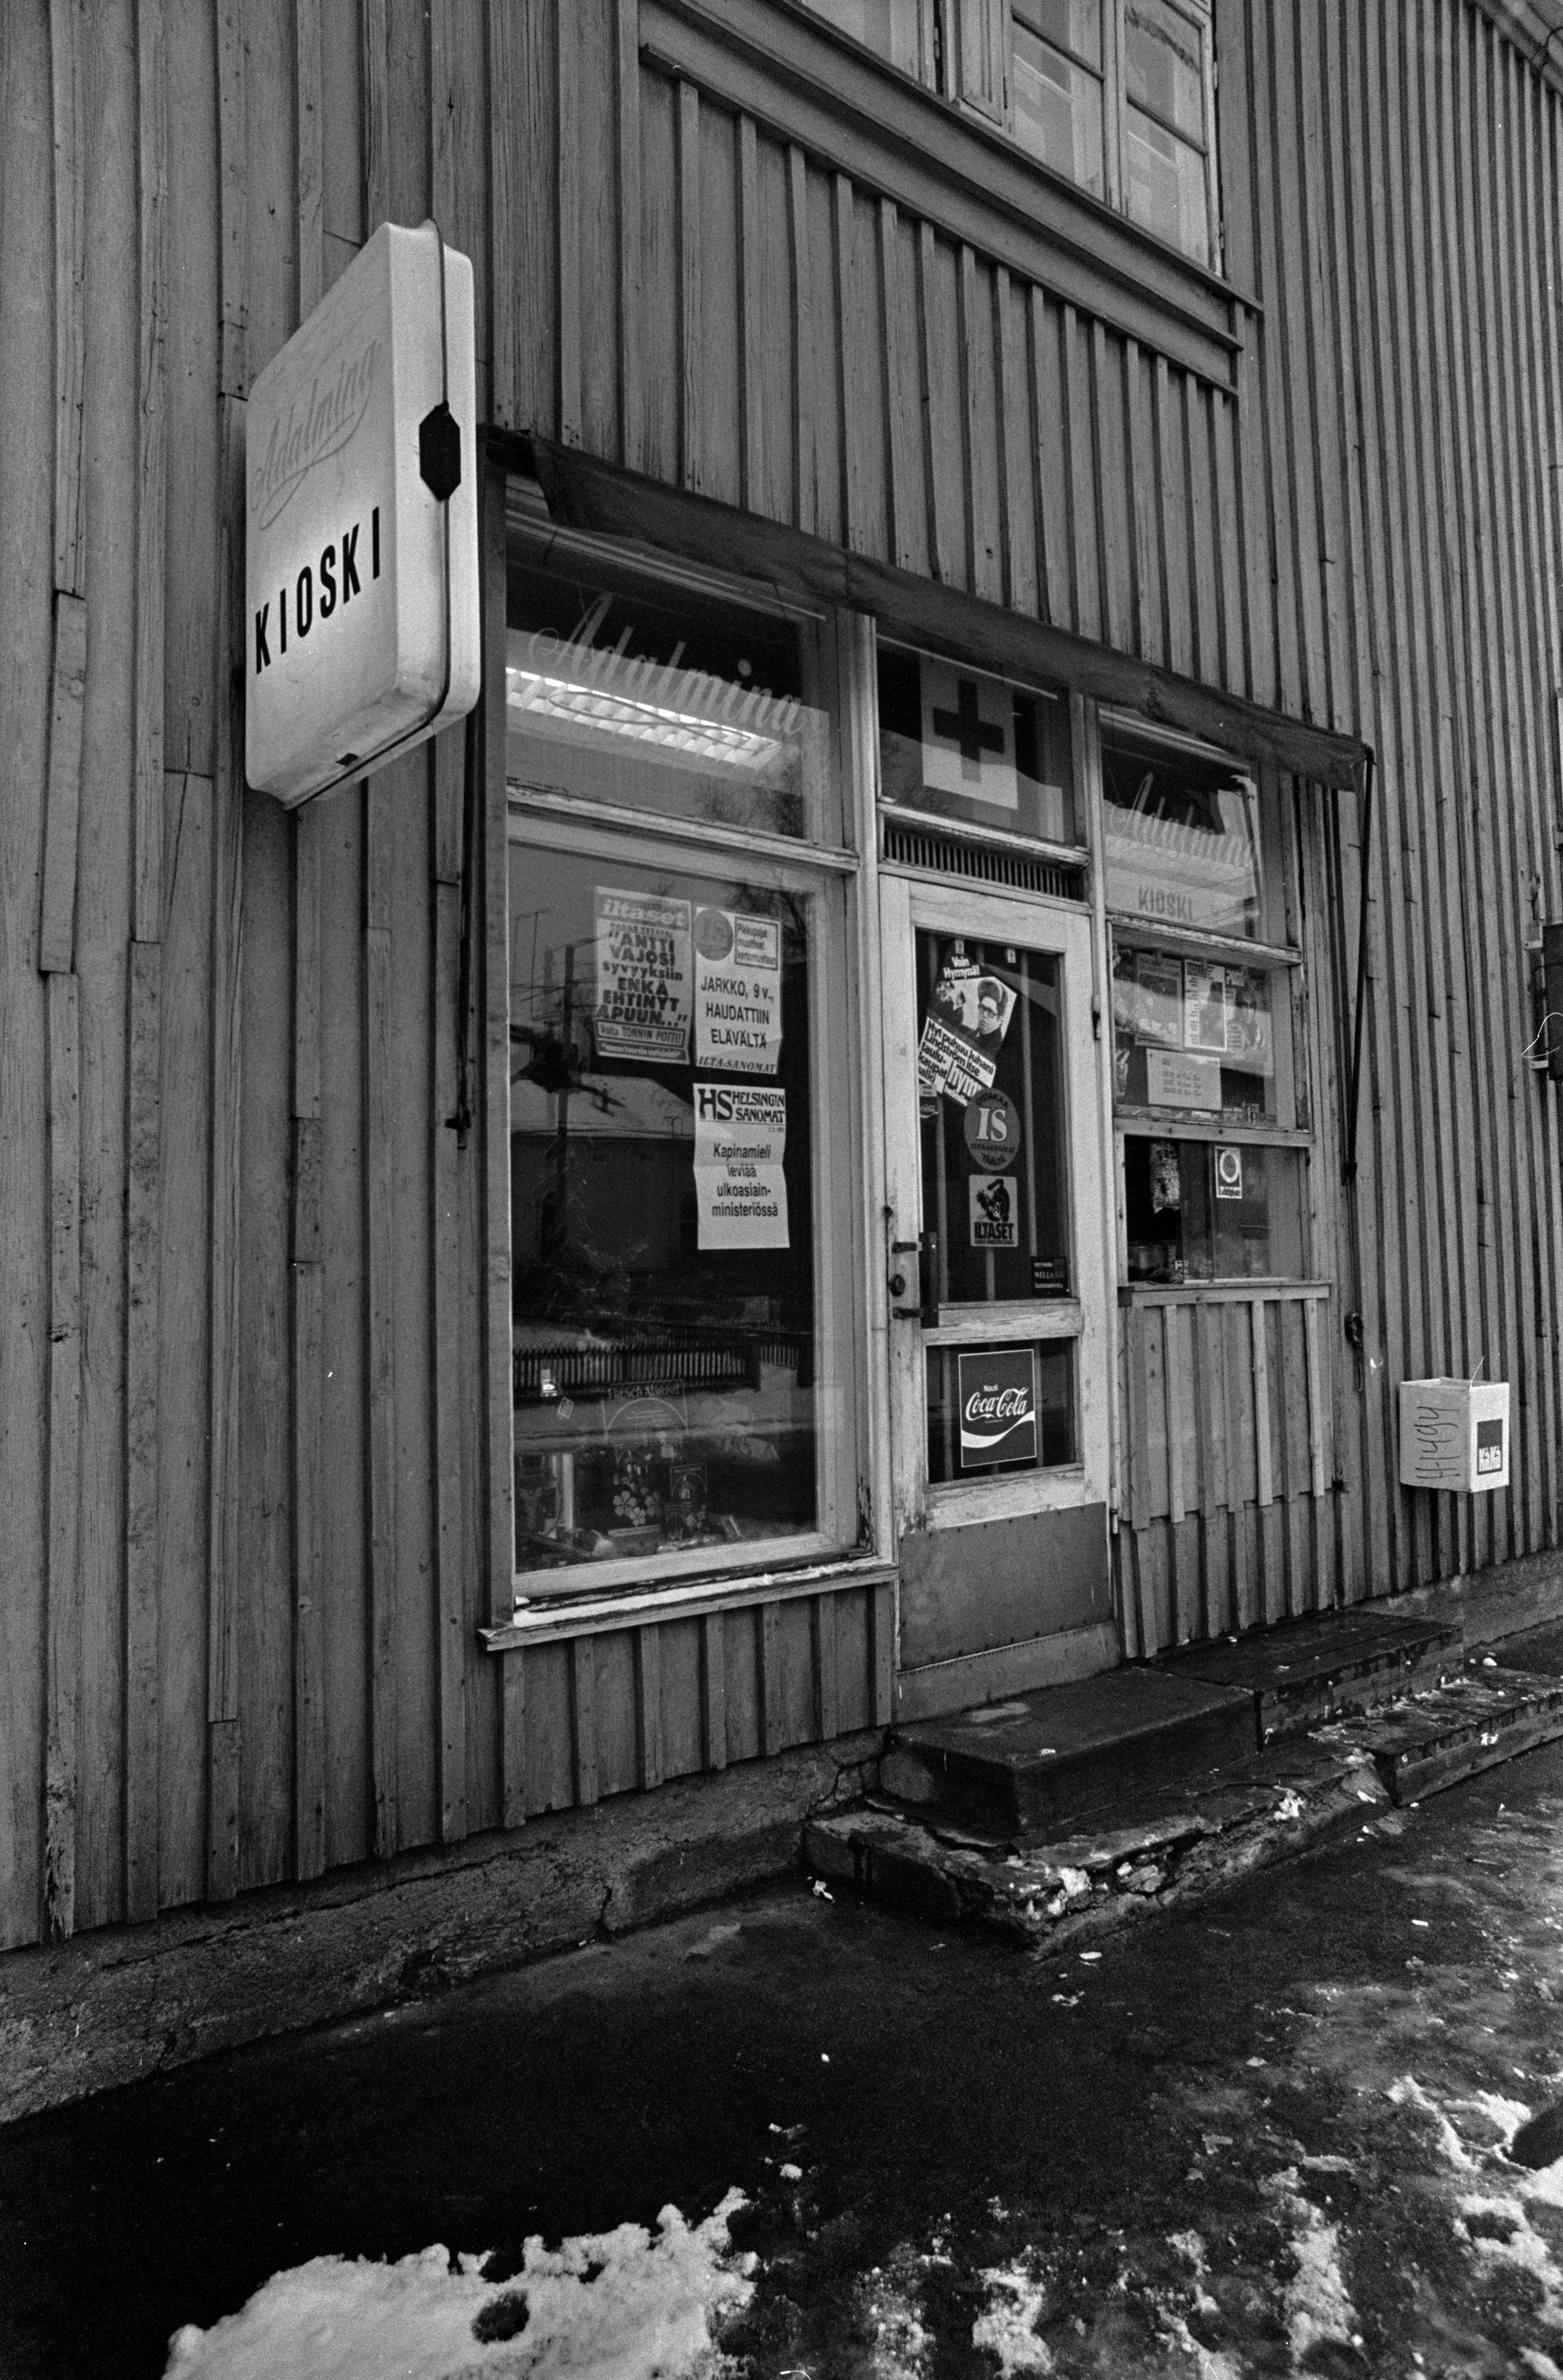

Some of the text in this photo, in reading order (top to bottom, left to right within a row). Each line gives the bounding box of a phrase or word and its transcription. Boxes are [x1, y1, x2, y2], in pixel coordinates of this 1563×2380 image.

[255, 506, 380, 675] KIOSKI
[528, 592, 806, 739] Adalmina
[602, 899, 685, 927] iltaset
[1138, 885, 1192, 921] KIOSKI
[609, 944, 675, 967] VAJOSI
[602, 961, 683, 981] syvyyksiin
[618, 977, 669, 996] ENKÄ
[701, 976, 748, 1000] JARKKO,
[753, 983, 760, 998] 9
[603, 989, 679, 1012] EHTINYT
[706, 1002, 770, 1025] HAUDATTIIN
[622, 1026, 653, 1039] TONNIN
[711, 1028, 767, 1049] ELÄVÄLTÄ
[921, 1041, 946, 1064] taulu-
[924, 1030, 981, 1077] Lindström itse
[927, 1022, 994, 1075] Nyt puhuu Juhani
[918, 1051, 948, 1080] kaupat
[698, 1089, 733, 1121] HS
[732, 1091, 785, 1107] HELSINGIN
[736, 1108, 785, 1124] SANOMAT
[976, 1107, 1008, 1142] IS
[714, 1143, 771, 1161] Kapinamieli
[727, 1163, 757, 1177] leviää
[717, 1182, 771, 1197] ulkoasiain-
[712, 1202, 778, 1217] ministeriössä
[974, 1222, 1014, 1240] ILTASET
[965, 1387, 1029, 1421] Coca-Cola
